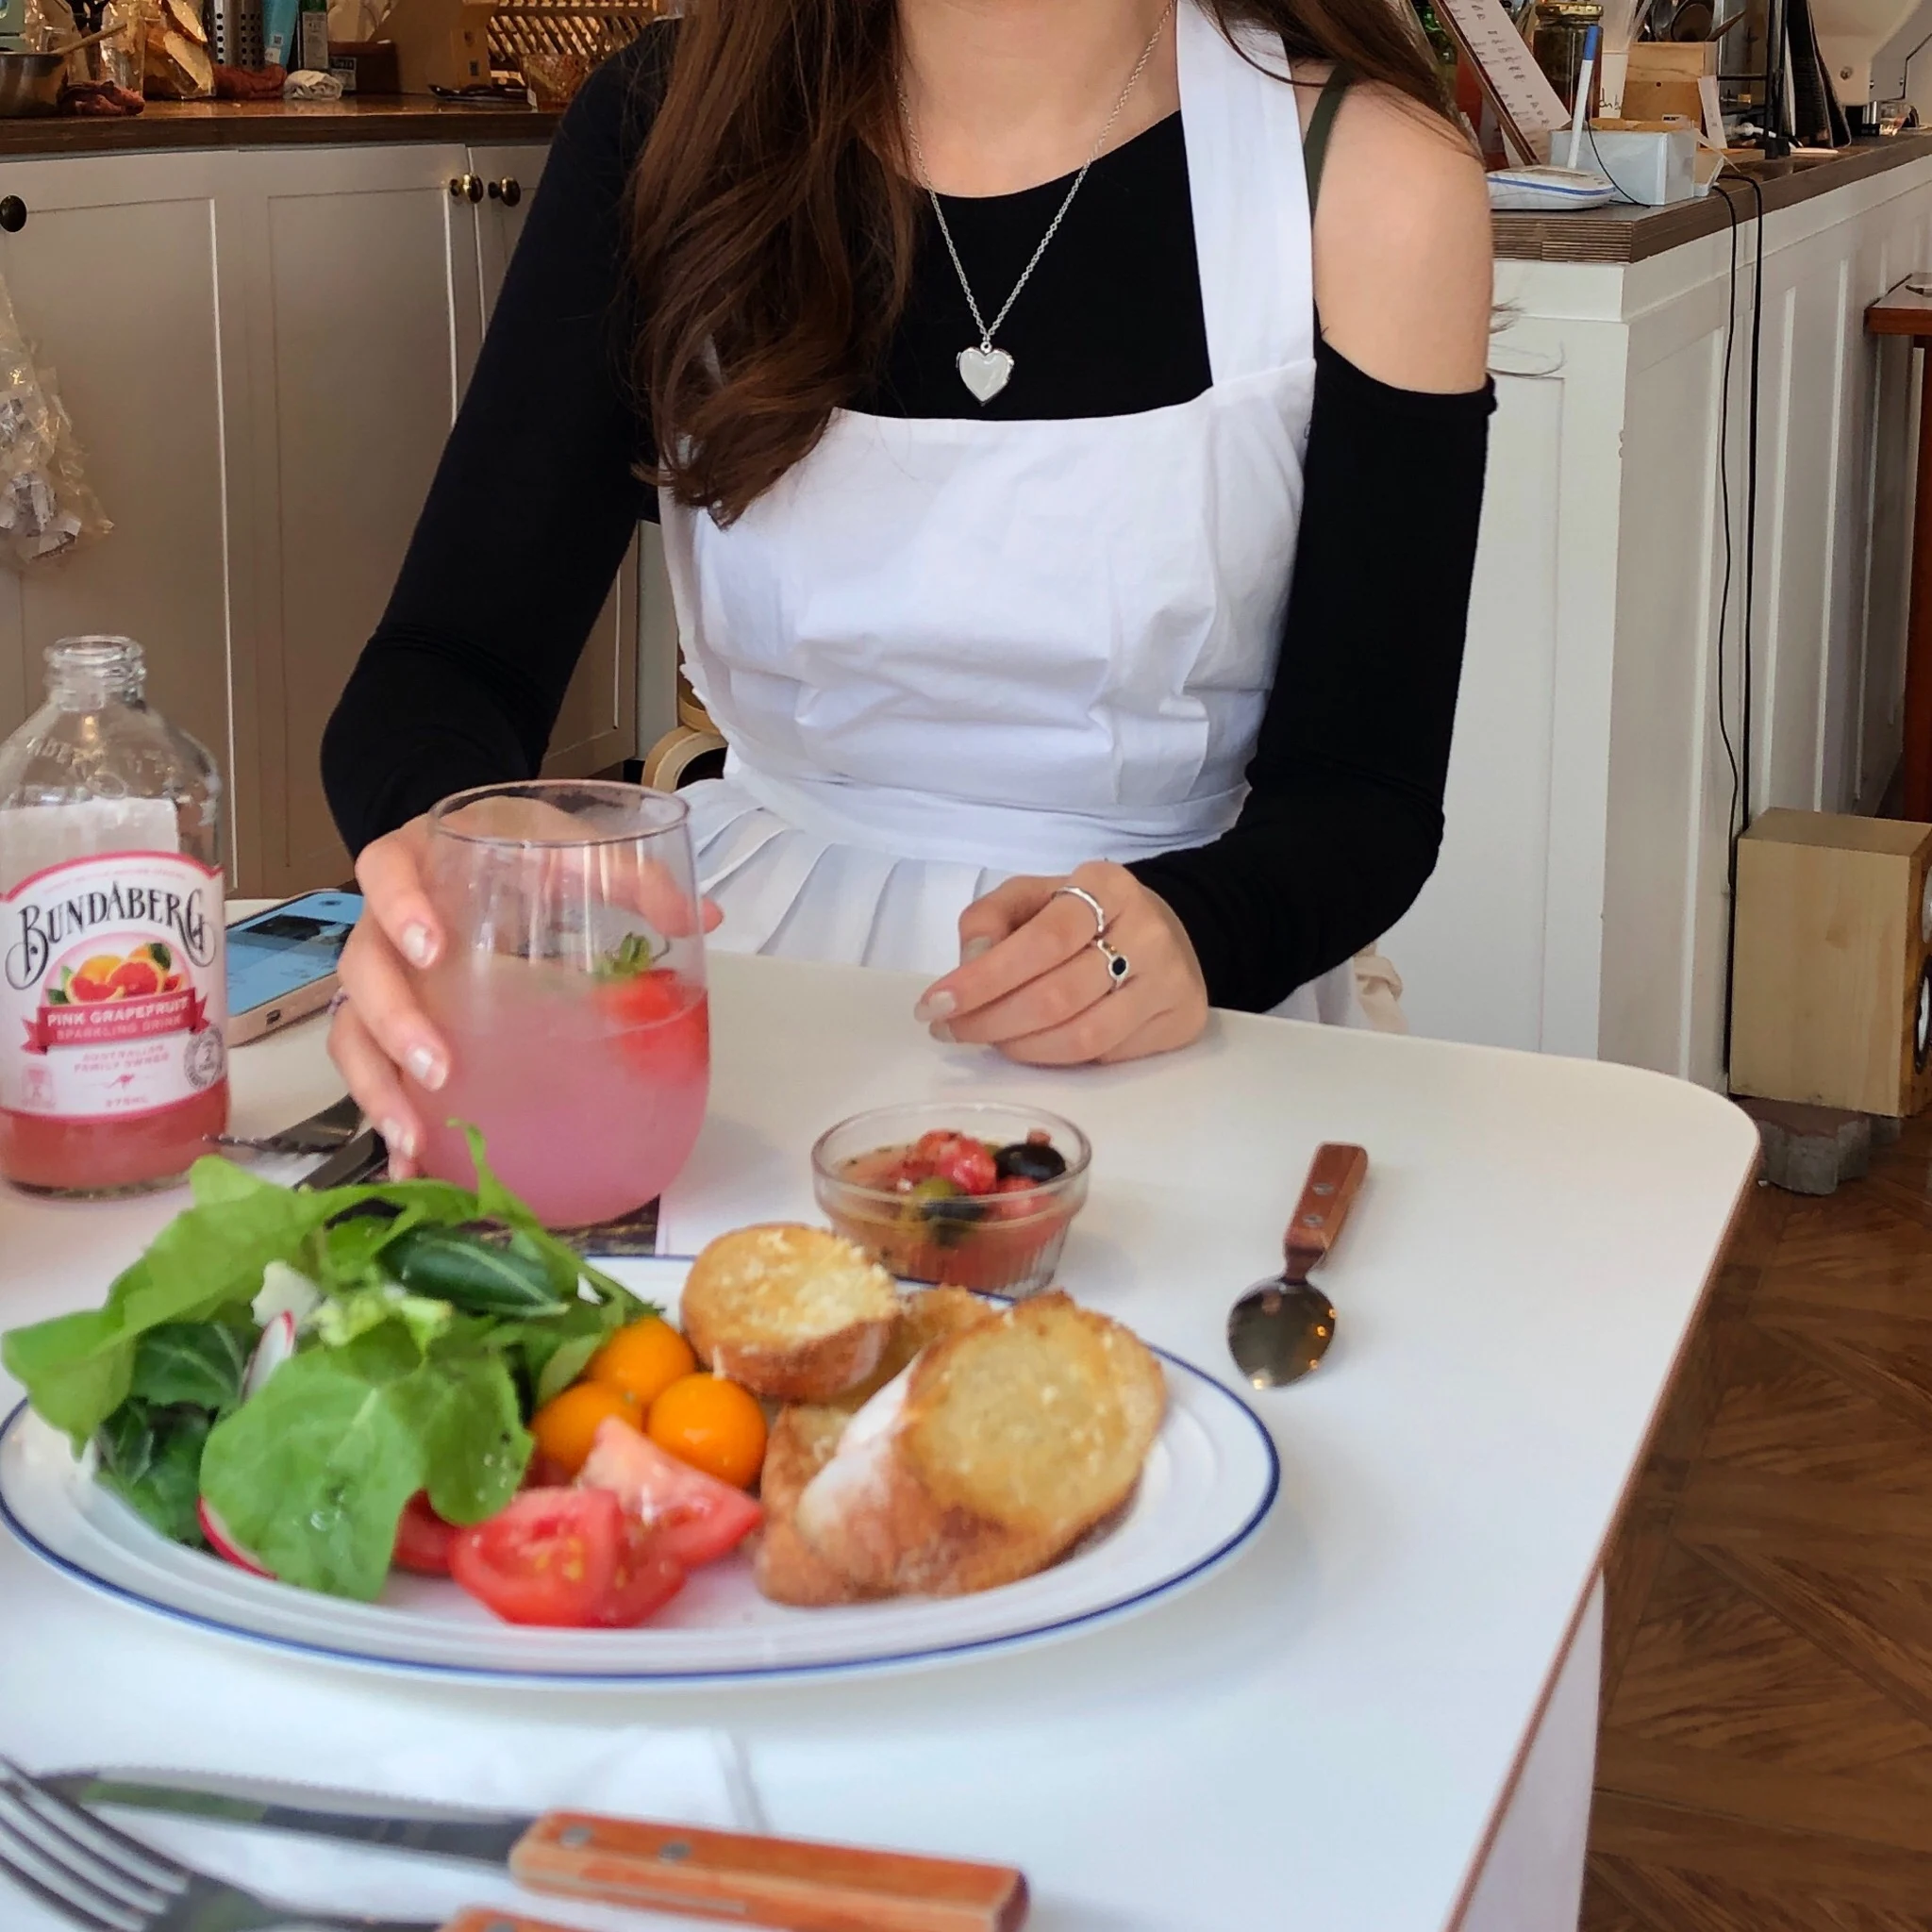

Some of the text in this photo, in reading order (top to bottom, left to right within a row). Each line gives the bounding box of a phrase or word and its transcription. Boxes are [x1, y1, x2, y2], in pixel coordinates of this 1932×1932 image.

[5, 881, 216, 991] BUNDABERG
[47, 996, 190, 1027] PINK GRAPEFRUIT
[56, 1016, 183, 1041] SPARKLING DRINK
